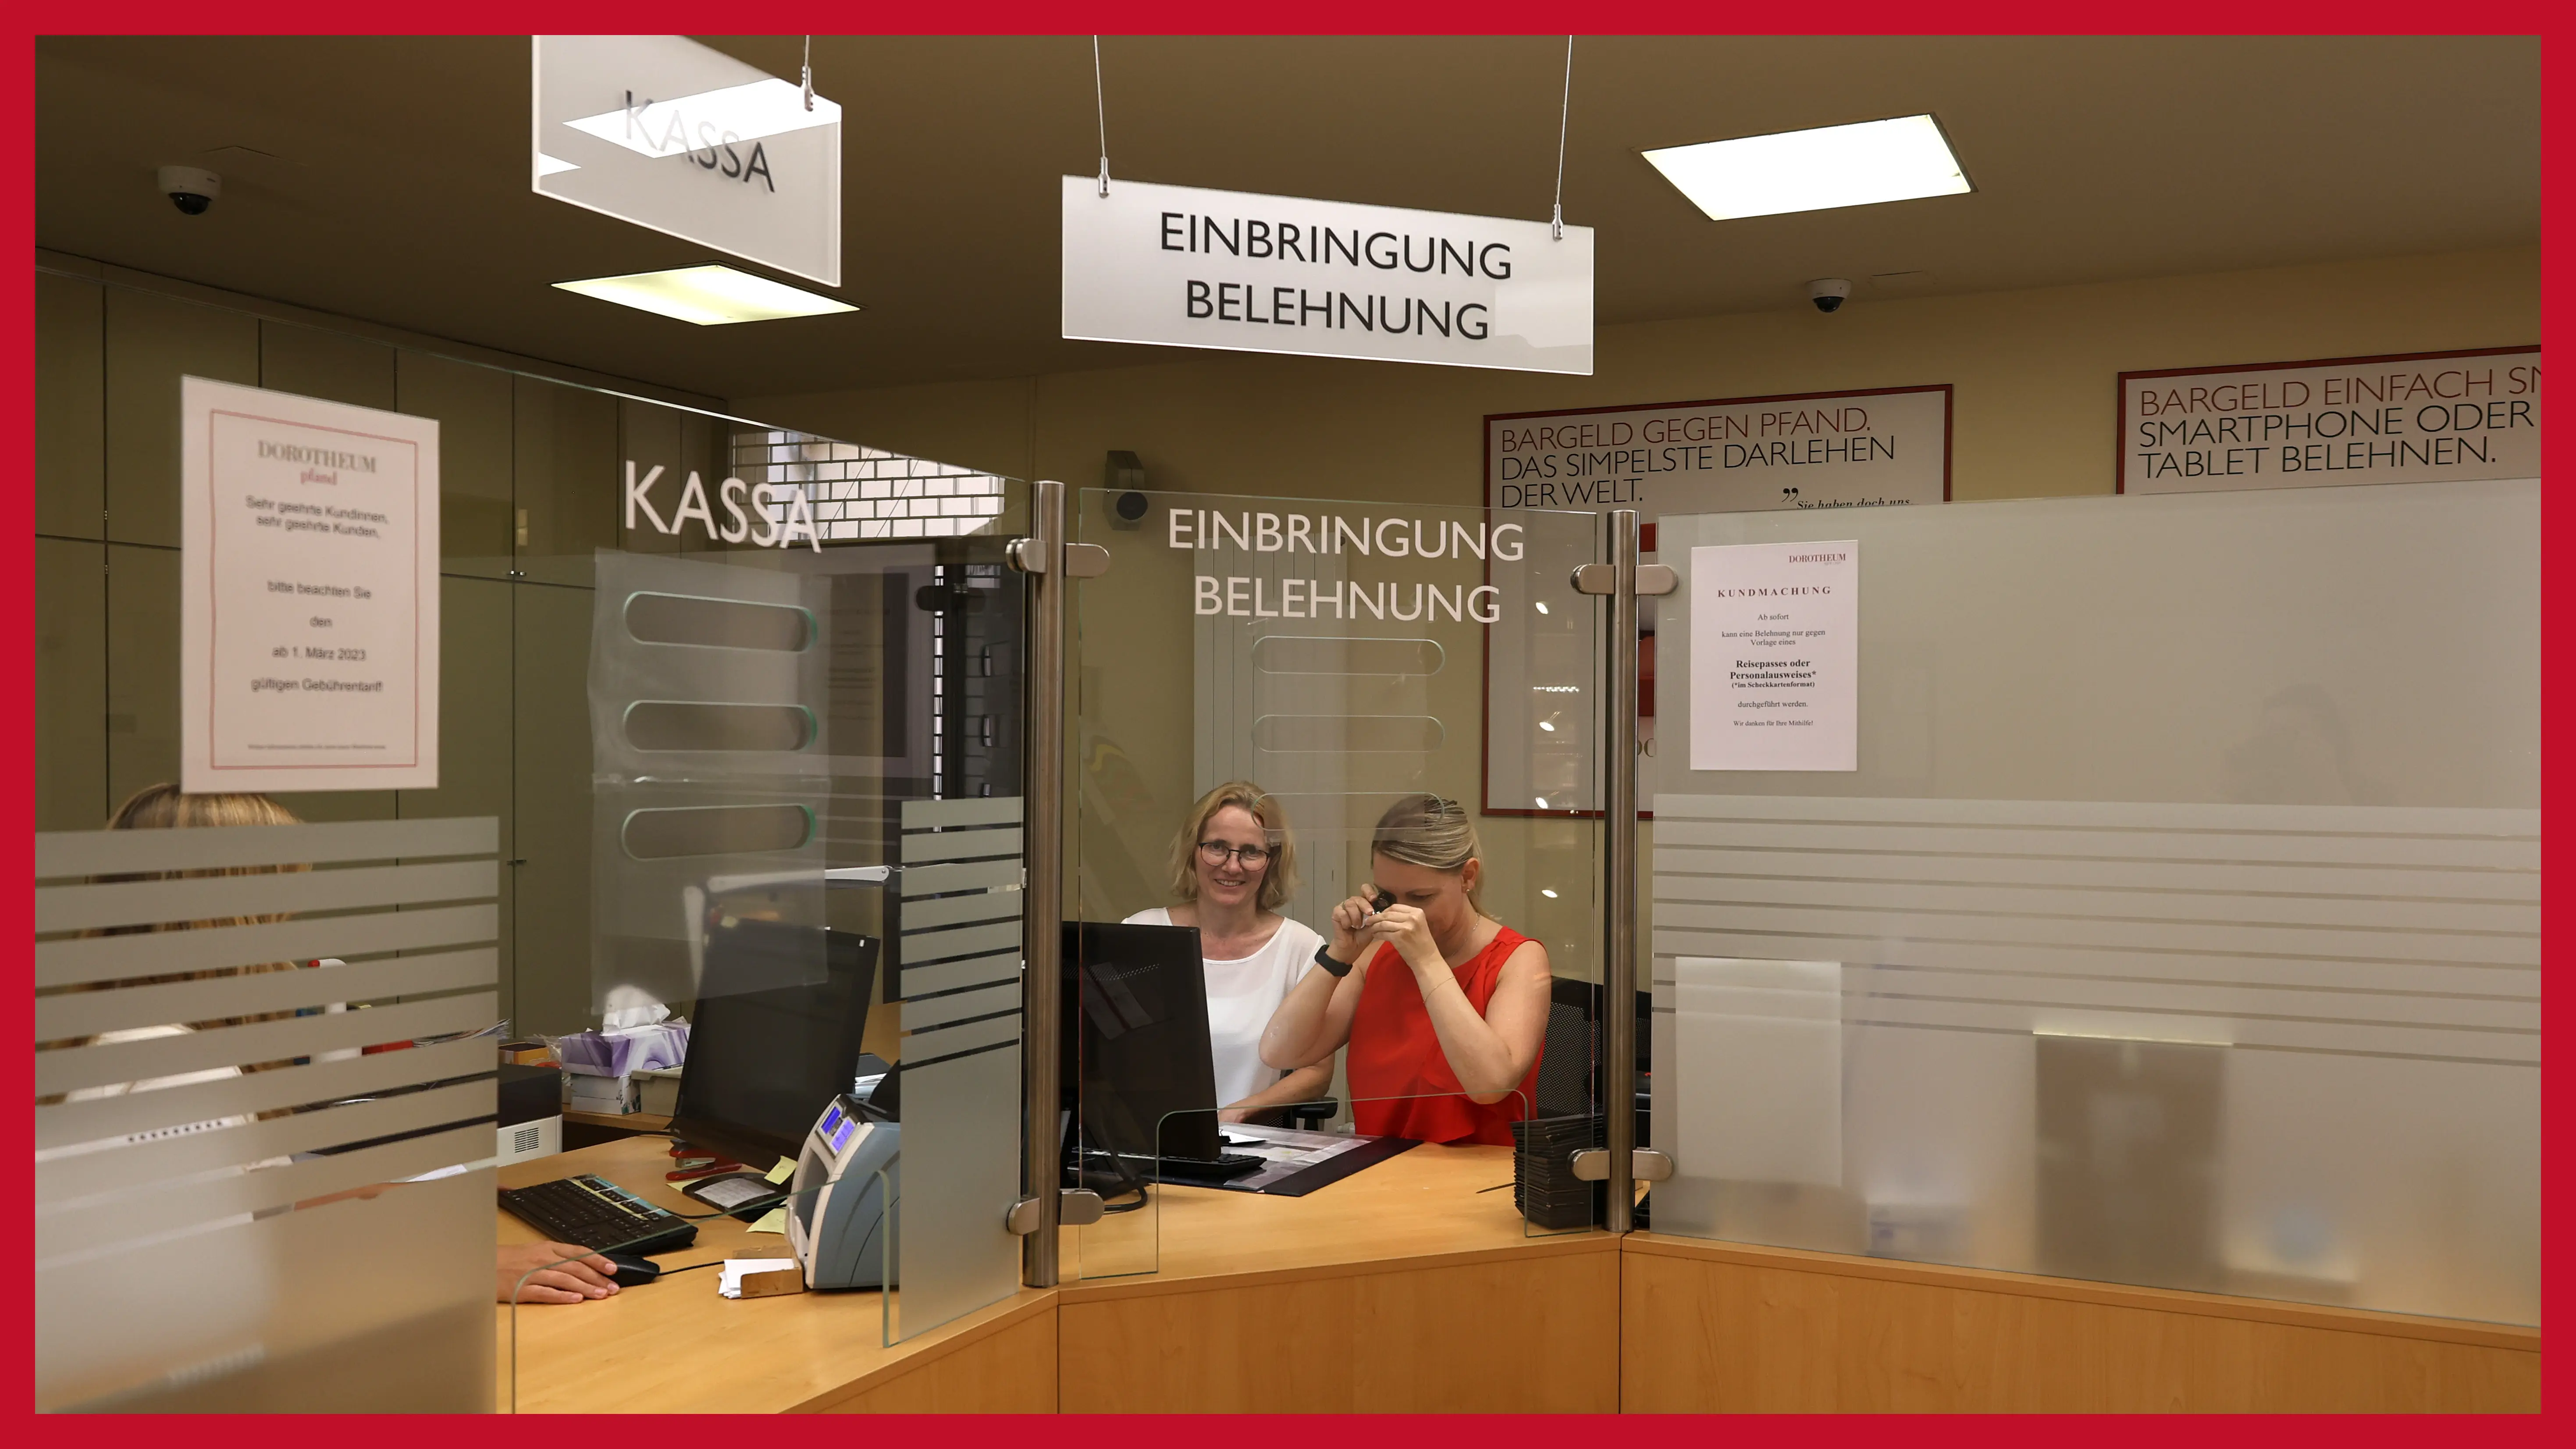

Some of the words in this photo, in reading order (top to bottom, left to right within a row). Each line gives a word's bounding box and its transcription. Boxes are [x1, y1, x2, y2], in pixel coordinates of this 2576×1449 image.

[626, 90, 775, 192] KASSA
[1161, 212, 1511, 279] EINBRINGUNG
[1187, 280, 1488, 340] BELEHNUNG
[2141, 381, 2310, 416] BARGELD
[2324, 369, 2492, 406] EINFACH
[1502, 422, 1633, 452] BARGELD
[1643, 414, 1748, 443] GEGEN
[1761, 407, 1870, 437] PFAND.
[2140, 407, 2402, 448] SMARTPHONE
[2417, 400, 2534, 432] ODER
[257, 440, 376, 473] DOROTHEUM
[1502, 455, 1557, 480] DAS
[1566, 445, 1712, 477] SIMPELSTE
[1724, 435, 1894, 469] DARLEHEN
[2138, 447, 2270, 478] TABLET
[2282, 436, 2496, 472] BELEHNEN.
[246, 495, 275, 510] Sehr
[278, 502, 322, 516] geehrte
[626, 460, 822, 553] KASSA
[1502, 483, 1558, 508] DER
[1562, 478, 1643, 505] WELT.
[256, 515, 282, 527] sehr
[285, 519, 331, 534] geehrte
[1169, 508, 1523, 561] EINBRINGUNG
[1789, 553, 1846, 563] DOROTHEUM
[267, 580, 294, 594] bitte
[297, 582, 350, 598] beachten
[353, 586, 371, 599] Sie
[1195, 575, 1500, 623] BELEHNUNG
[1718, 586, 1831, 597] KUNDMACHUNG
[310, 616, 332, 628] den
[272, 646, 288, 658] ab
[306, 647, 334, 660] März
[337, 648, 366, 661] 2023
[1736, 660, 1787, 669] Reisepasses
[1790, 659, 1811, 667] oder
[251, 677, 299, 693] gültigen
